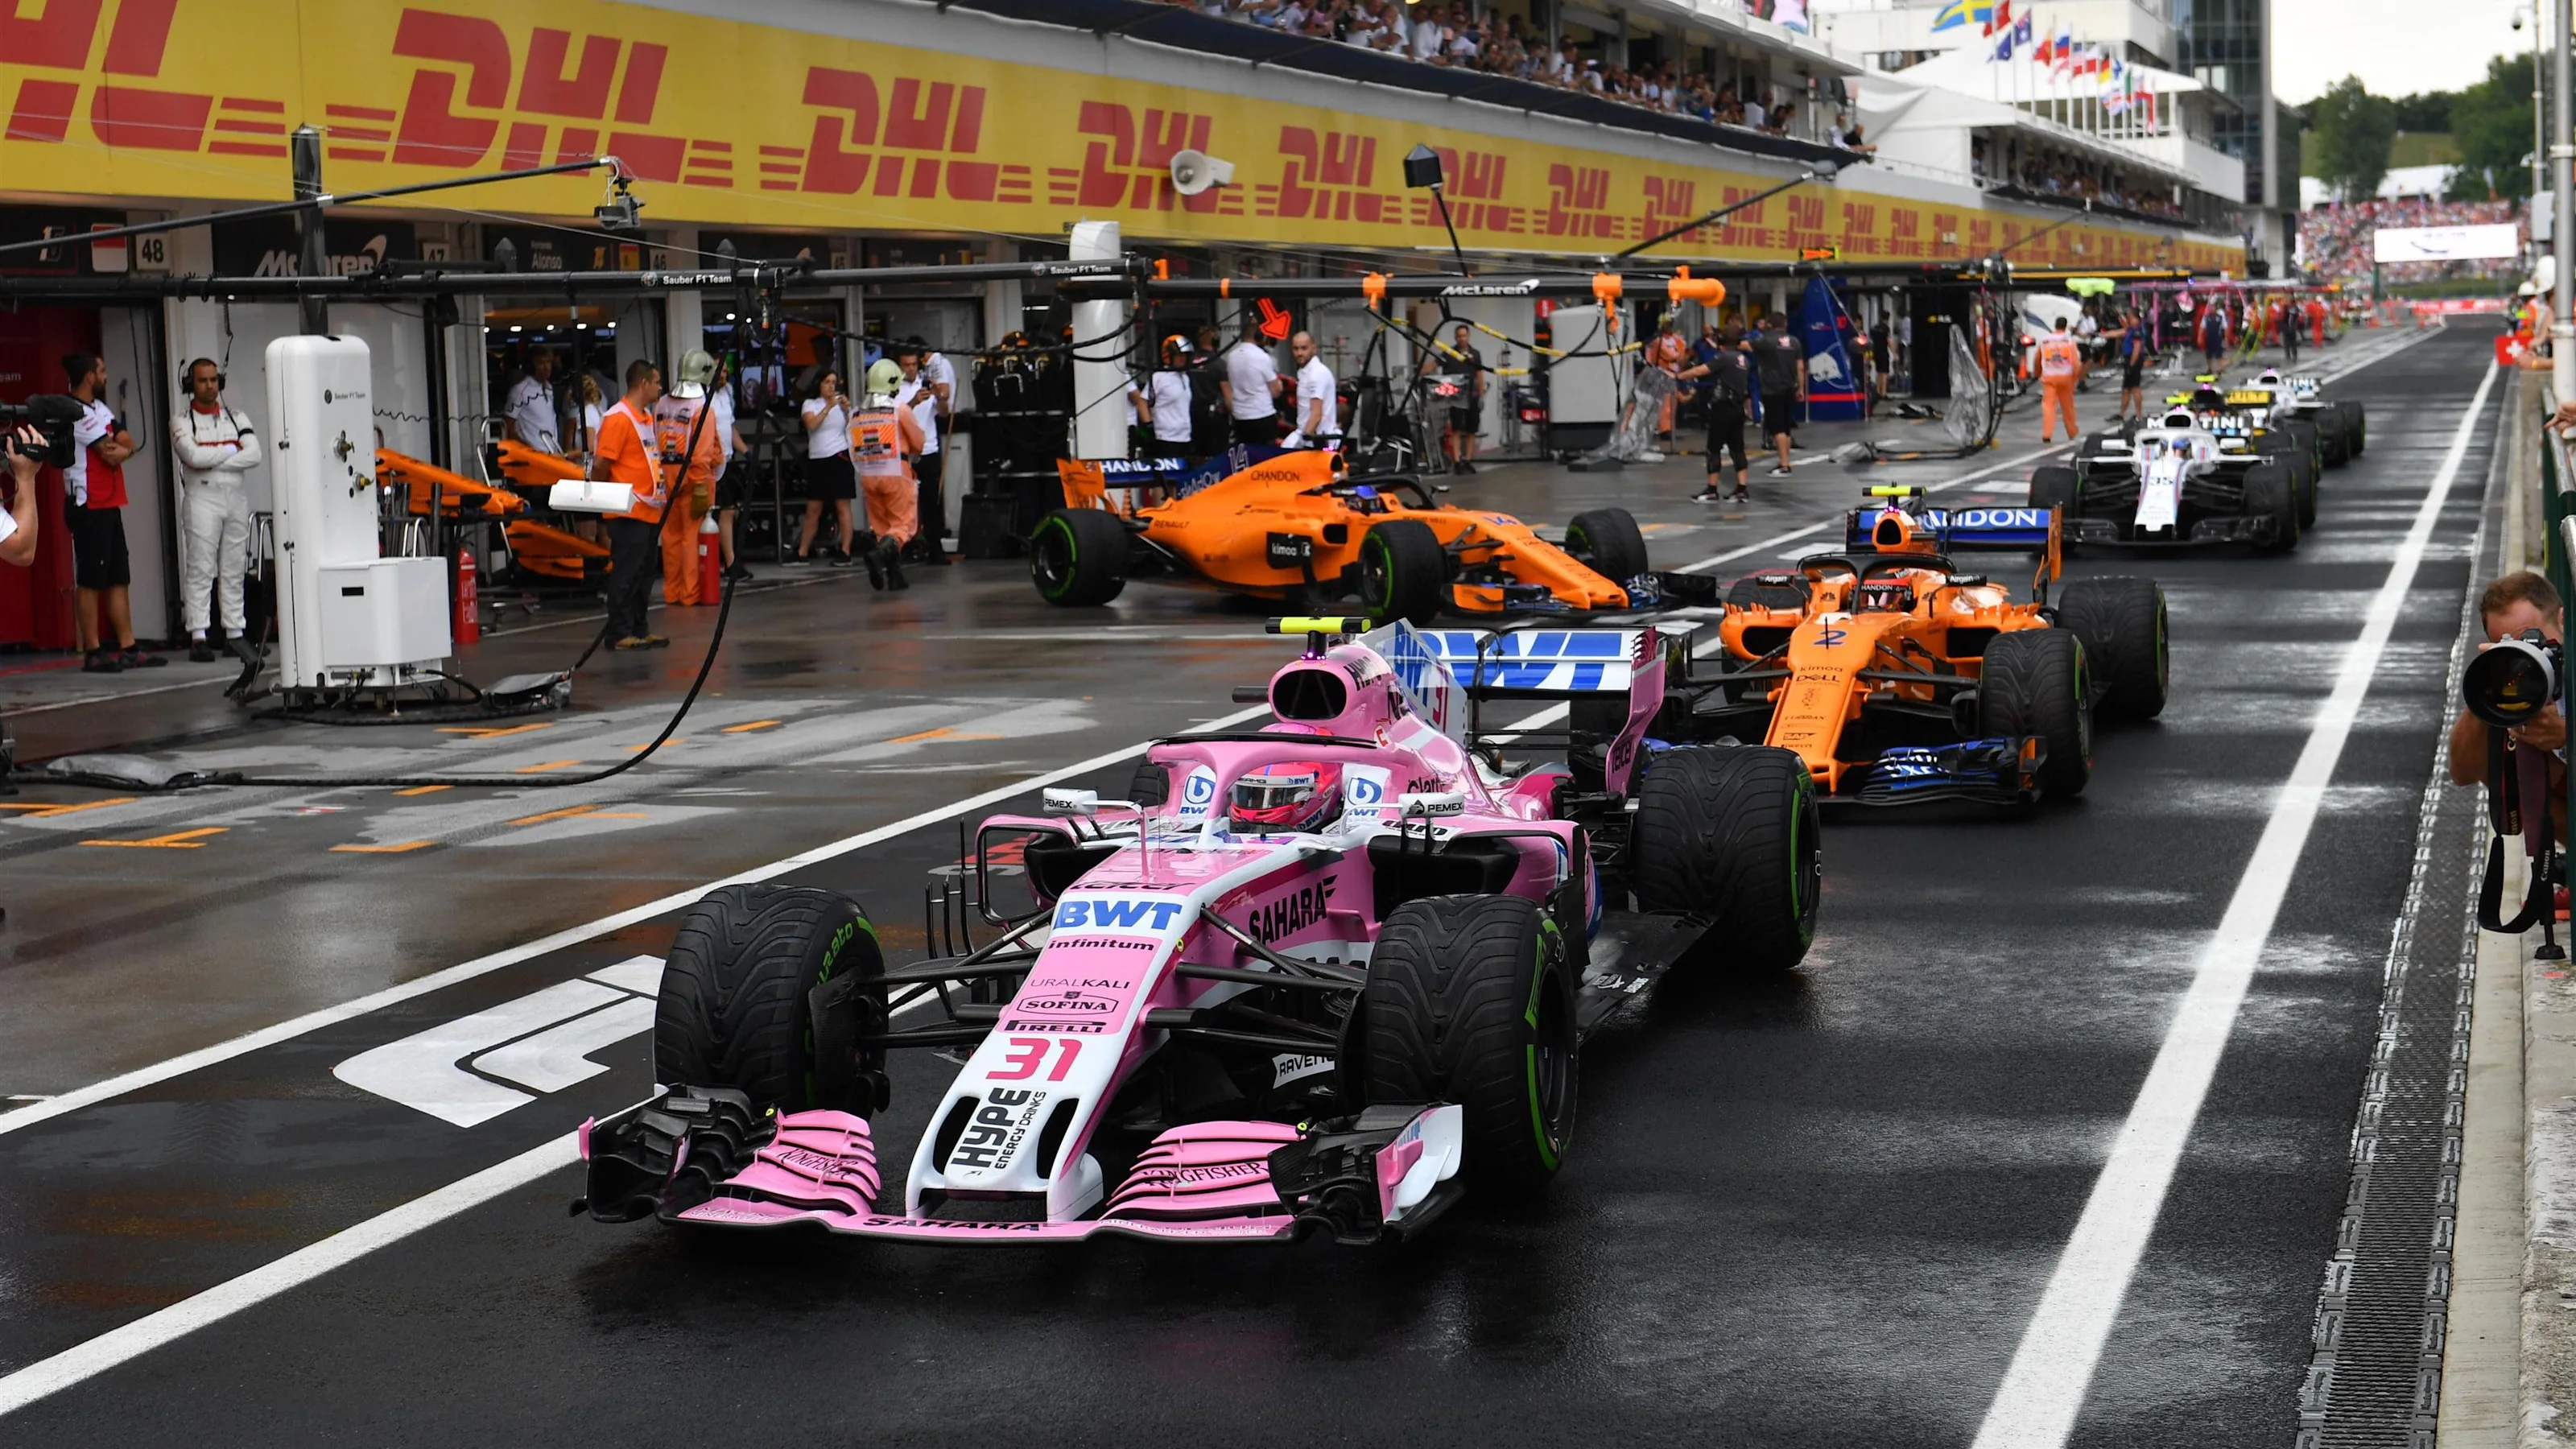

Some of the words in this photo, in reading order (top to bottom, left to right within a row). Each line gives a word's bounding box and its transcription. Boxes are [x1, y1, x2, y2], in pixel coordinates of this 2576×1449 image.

[0, 0, 213, 152] HL
[391, 7, 687, 184] DHL
[802, 65, 999, 202] DHL
[1078, 100, 1220, 215] DHL
[1277, 125, 1383, 223] DHL
[1426, 146, 1510, 232] DHL
[1546, 163, 1612, 239] DHL
[1642, 175, 1696, 244] DHL
[1722, 185, 1767, 248] DHL
[1786, 194, 1826, 250] DHL
[1843, 202, 1875, 254] DHL
[142, 238, 164, 263] 48
[253, 249, 375, 277] Mcren
[531, 252, 562, 270] Alonso
[1050, 266, 1078, 275] Sauber
[1079, 265, 1089, 274] F1
[1090, 265, 1112, 274] Team
[663, 275, 694, 285] Sauber
[696, 275, 708, 284] F1
[708, 275, 732, 284] Team
[1440, 285, 1529, 296] McLaren
[0, 371, 21, 382] eam
[2147, 416, 2244, 429] MTINI
[1100, 457, 1179, 473] HANDON
[1250, 469, 1301, 482] CHANDON
[1154, 520, 1190, 529] RENAULT
[1272, 543, 1297, 556] kimoa
[1765, 574, 1787, 584] Airgain
[1950, 573, 1974, 583] Airgain
[1814, 630, 1847, 646] 2
[1796, 674, 1841, 683] DELL
[1784, 733, 1812, 741] SAP
[1294, 777, 1310, 785] BWT
[1045, 798, 1073, 809] PEMEX
[1427, 802, 1463, 812] PEMEX
[1305, 808, 1323, 827] BWT
[2541, 848, 2551, 881] Canon
[1053, 900, 1183, 931] BWT
[1249, 881, 1327, 947] SAHARA
[819, 923, 853, 983] urato
[1048, 939, 1154, 951] infinitum
[1030, 979, 1130, 989] URALKALI
[1026, 1001, 1108, 1011] SOFINA
[1004, 1020, 1107, 1034] PIRELLI
[985, 1038, 1083, 1081] 31
[951, 1087, 1032, 1168] HYPE
[993, 1128, 1026, 1170] ENERGY
[1018, 1091, 1046, 1126] DRINKS
[777, 1147, 860, 1179] KINGFISHER
[1142, 1162, 1269, 1188] KINGFISHER
[862, 1216, 1041, 1233] SAHARA
